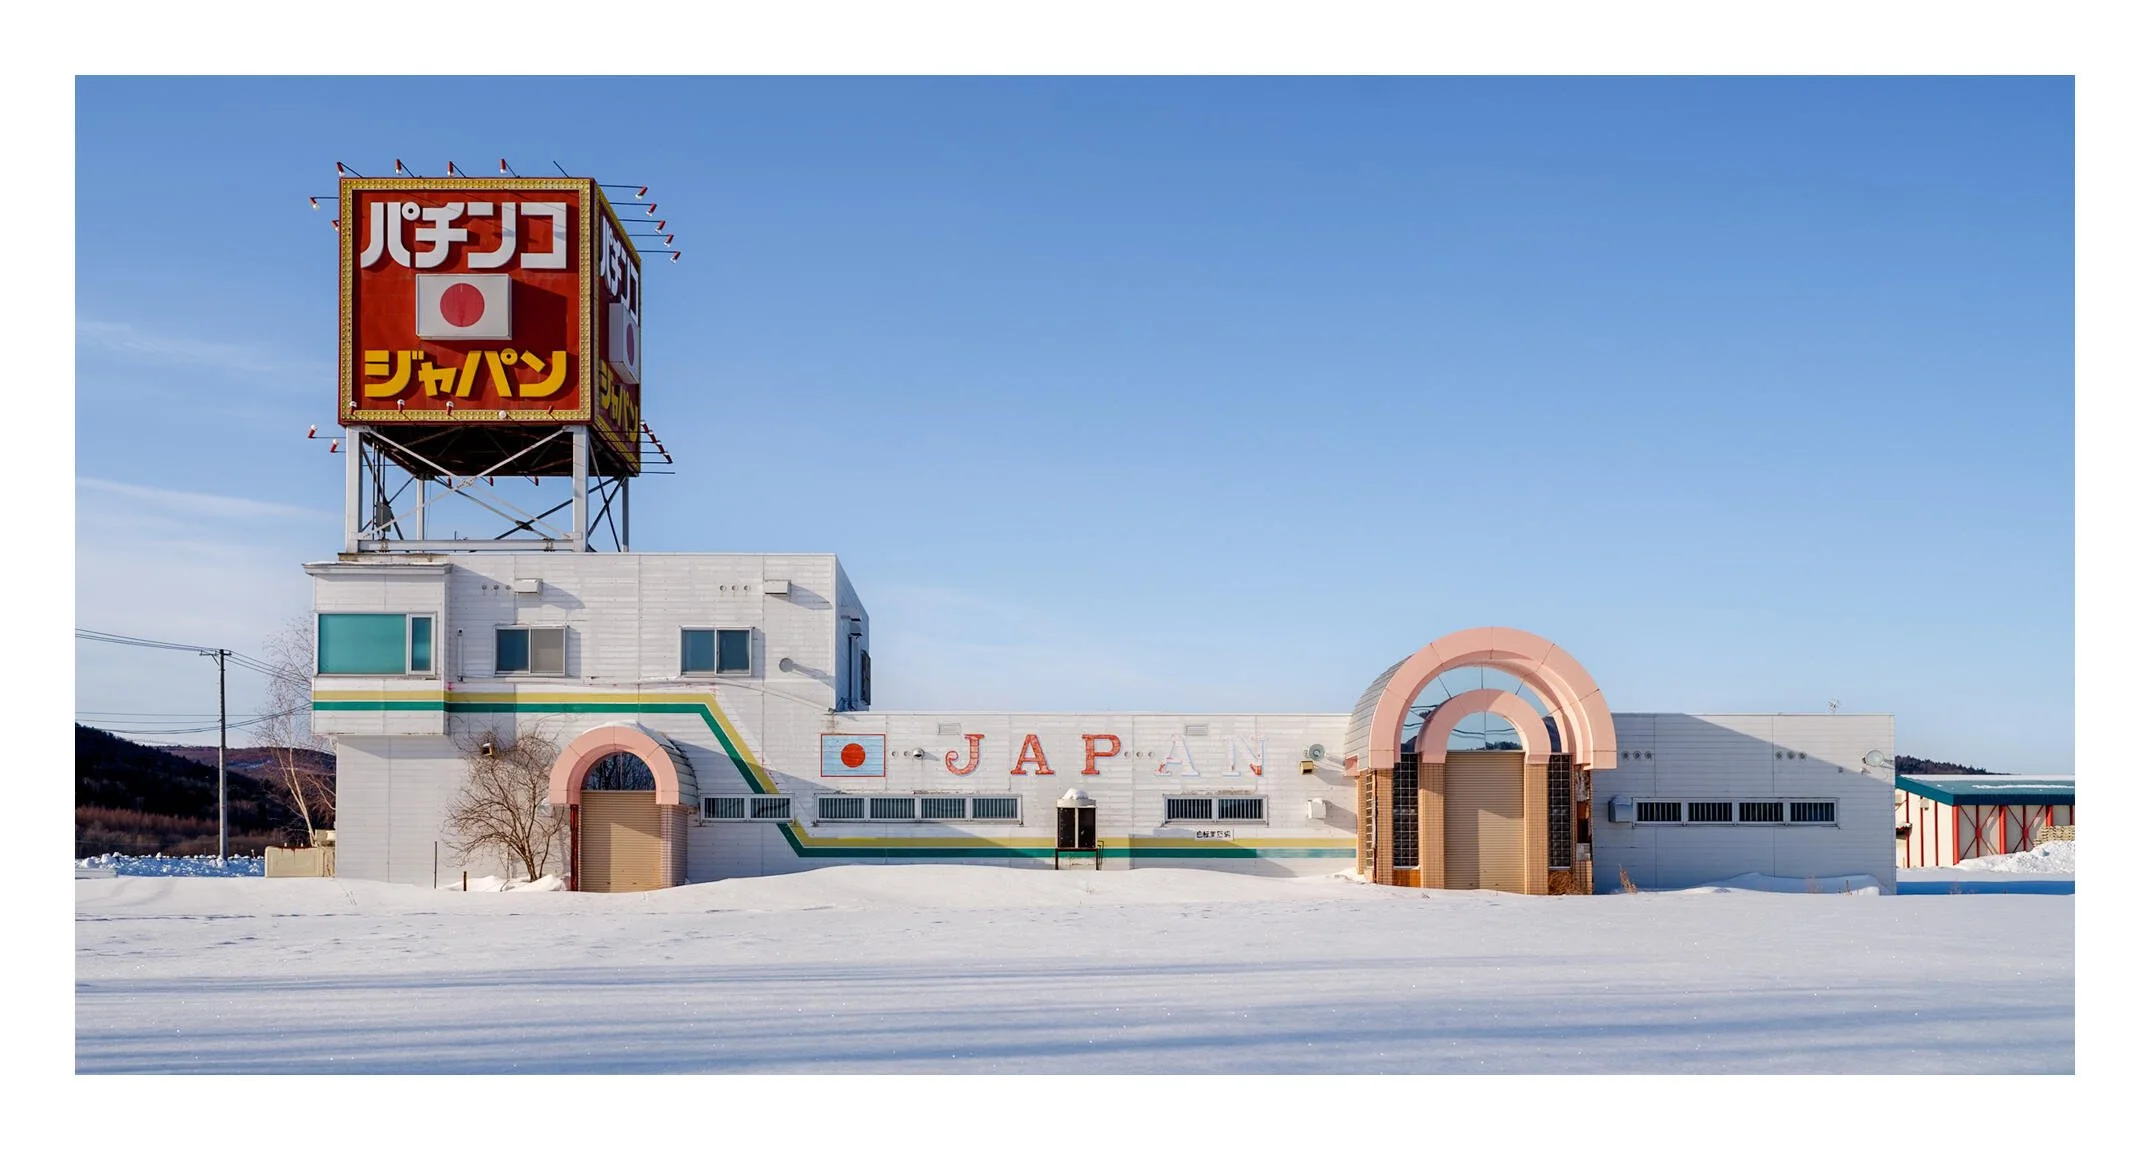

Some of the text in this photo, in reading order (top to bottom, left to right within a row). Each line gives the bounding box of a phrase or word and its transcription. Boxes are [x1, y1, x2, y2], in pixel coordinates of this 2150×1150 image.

[361, 201, 567, 269] パチンコ
[364, 348, 567, 398] ジャパン
[945, 733, 1268, 777] JAPAN
